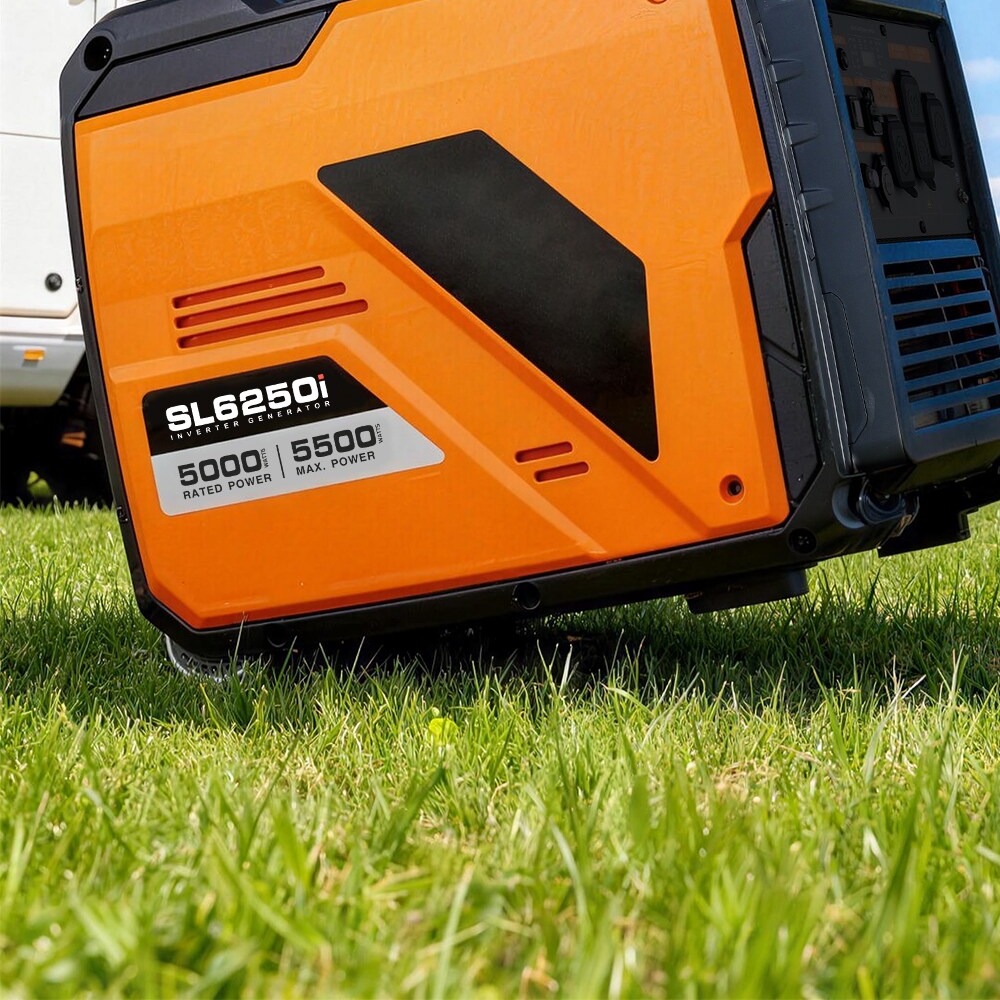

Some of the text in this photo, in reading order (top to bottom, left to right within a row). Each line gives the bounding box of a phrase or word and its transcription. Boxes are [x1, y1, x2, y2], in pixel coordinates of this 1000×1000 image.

[165, 373, 328, 432] SL6250i
[170, 401, 331, 441] INVERTER GENERATOR
[291, 425, 377, 462] 5500
[178, 449, 262, 486] 5000
[296, 451, 376, 476] MAX. POWER
[183, 473, 272, 500] RATED POWER
